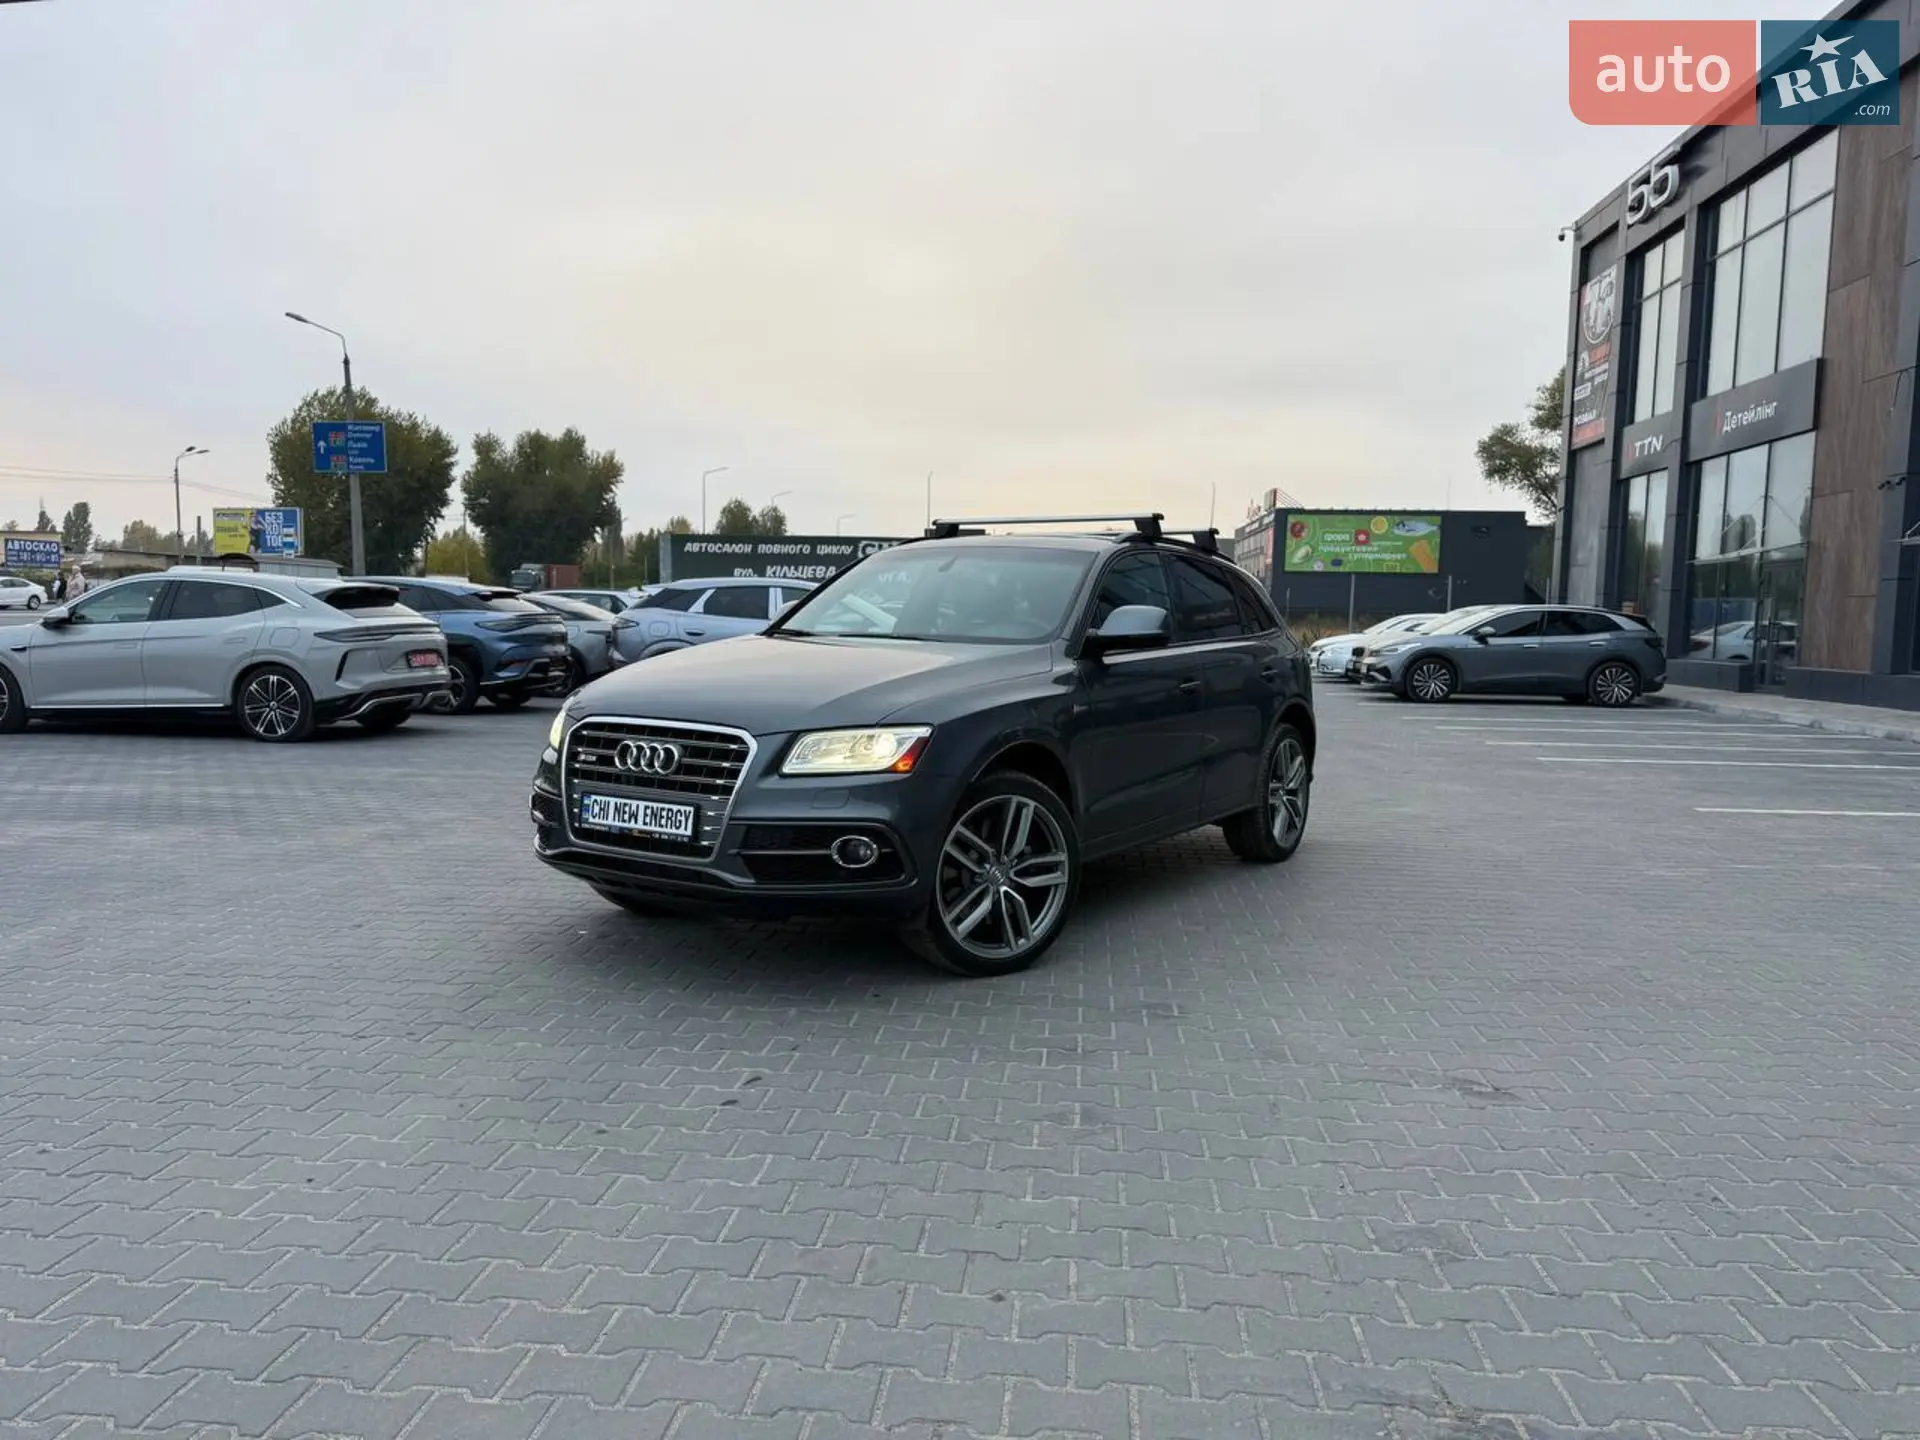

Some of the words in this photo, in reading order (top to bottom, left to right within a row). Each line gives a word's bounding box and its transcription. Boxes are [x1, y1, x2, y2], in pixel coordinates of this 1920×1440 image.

[1626, 146, 1680, 225] 55
[1722, 400, 1778, 435] Детейлінг
[1633, 434, 1664, 457] TTN
[264, 511, 284, 523] БЕЗ
[7, 539, 58, 553] АВТОСКЛО
[684, 542, 753, 554] АВТОСАЛОН
[757, 543, 811, 555] ПОВНОГО
[816, 544, 854, 556] ЦИКЛУ
[765, 565, 837, 579] КІЛЬЦЕВА
[591, 798, 610, 821] CHI
[613, 801, 640, 825] NEW
[642, 804, 692, 832] ENERGY
